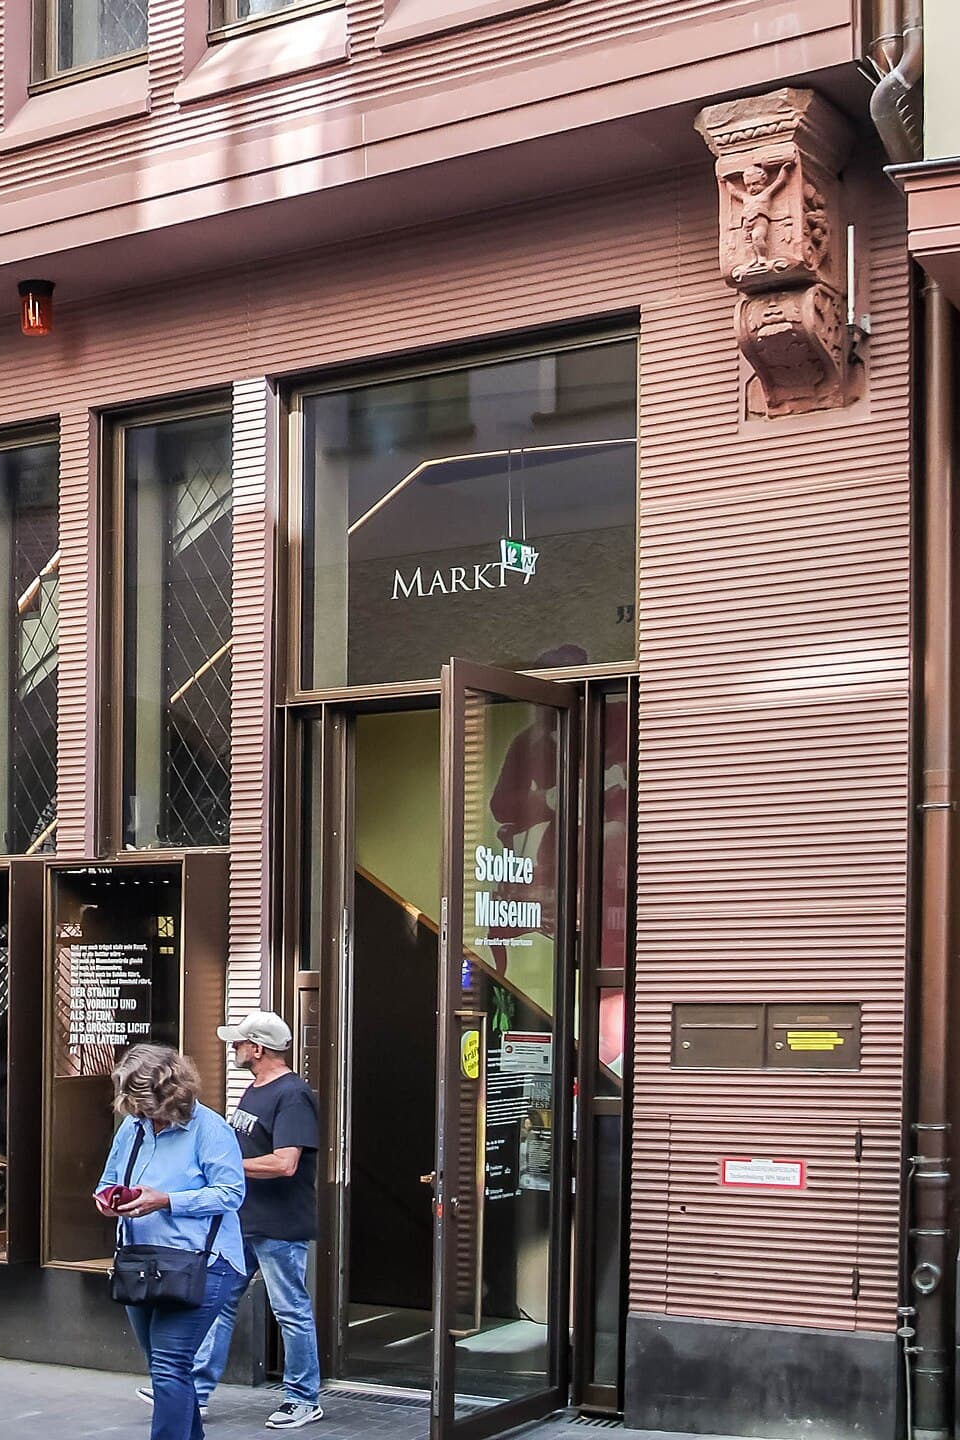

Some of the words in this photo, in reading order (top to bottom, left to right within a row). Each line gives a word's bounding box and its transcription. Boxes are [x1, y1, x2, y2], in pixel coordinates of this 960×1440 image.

[391, 562, 510, 600] MARKT
[475, 845, 533, 884] Stoltze
[475, 891, 541, 928] Museum
[70, 987, 85, 997] DER
[87, 987, 121, 997] STRAHLT
[70, 999, 85, 1009] ALS
[120, 999, 137, 1009] UND
[70, 1010, 85, 1021] ALS
[70, 1022, 85, 1033] ALS
[127, 1022, 150, 1033] LICHT
[79, 1034, 95, 1044] DER
